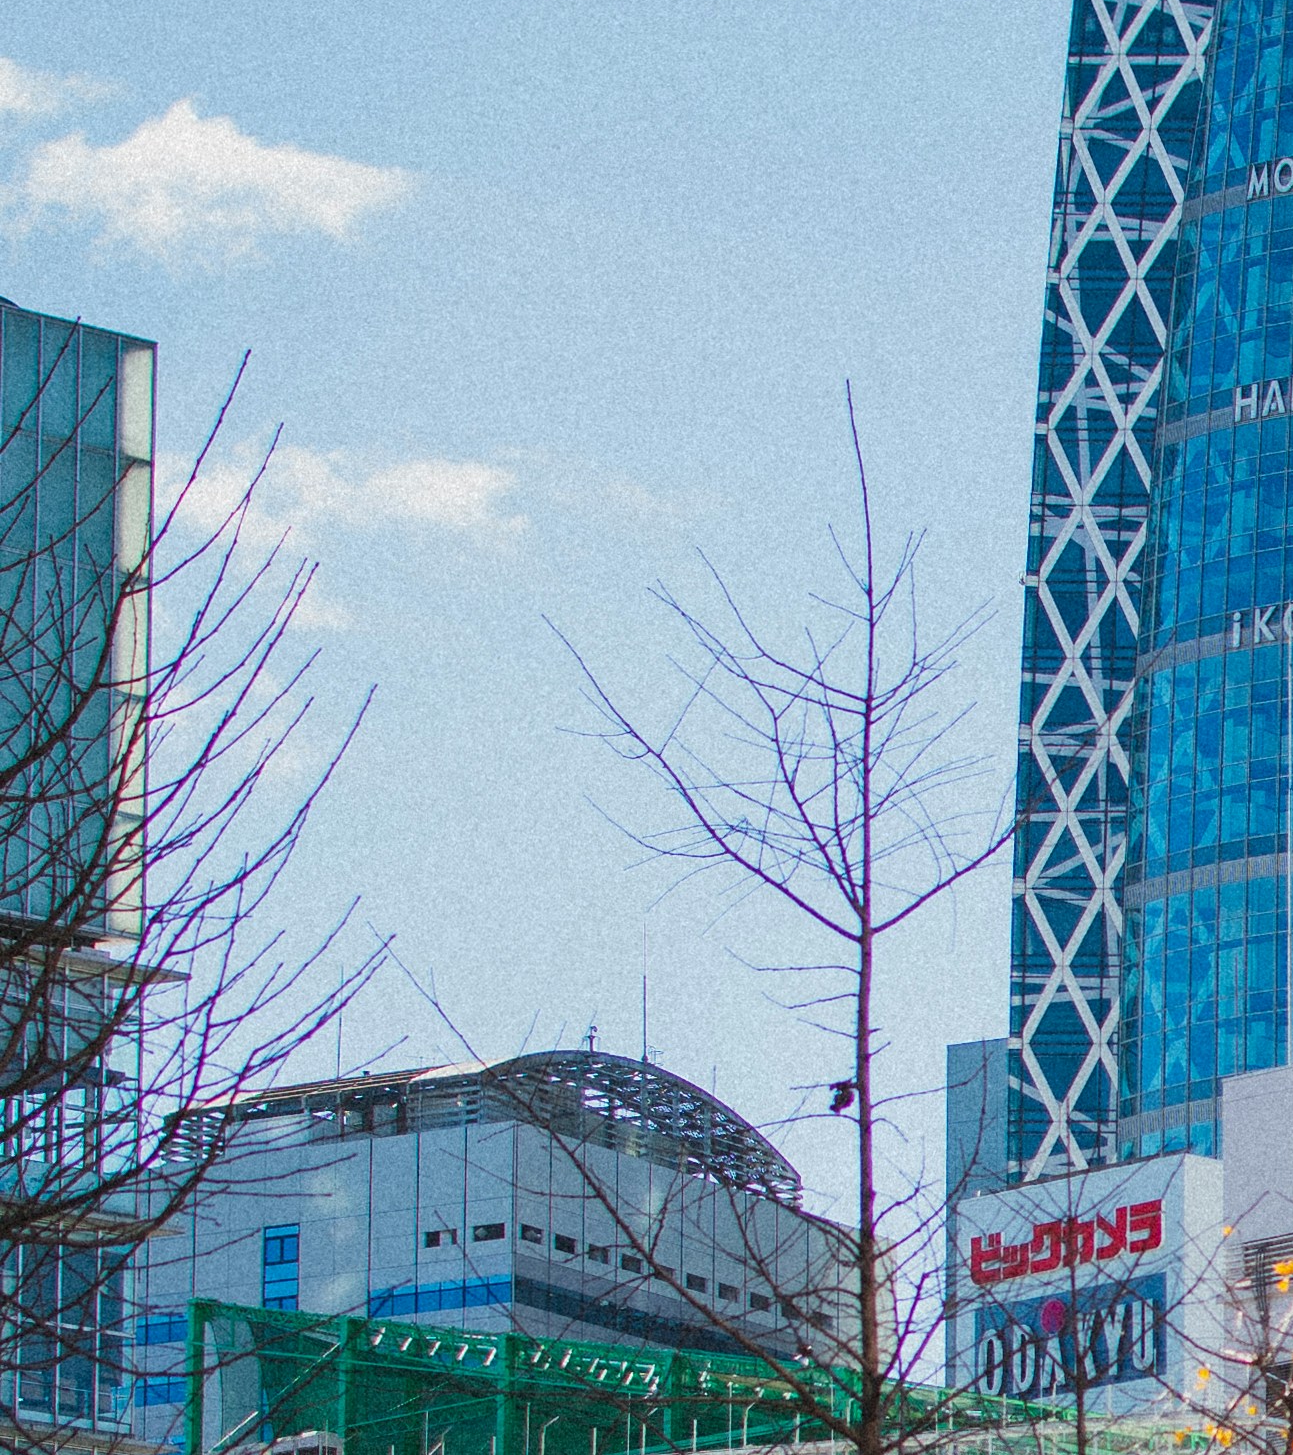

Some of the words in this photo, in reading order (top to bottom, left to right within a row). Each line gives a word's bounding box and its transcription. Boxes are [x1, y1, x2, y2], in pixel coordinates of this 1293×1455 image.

[970, 1199, 1164, 1285] ビックカメラ
[977, 1298, 1155, 1397] ODAKYU
